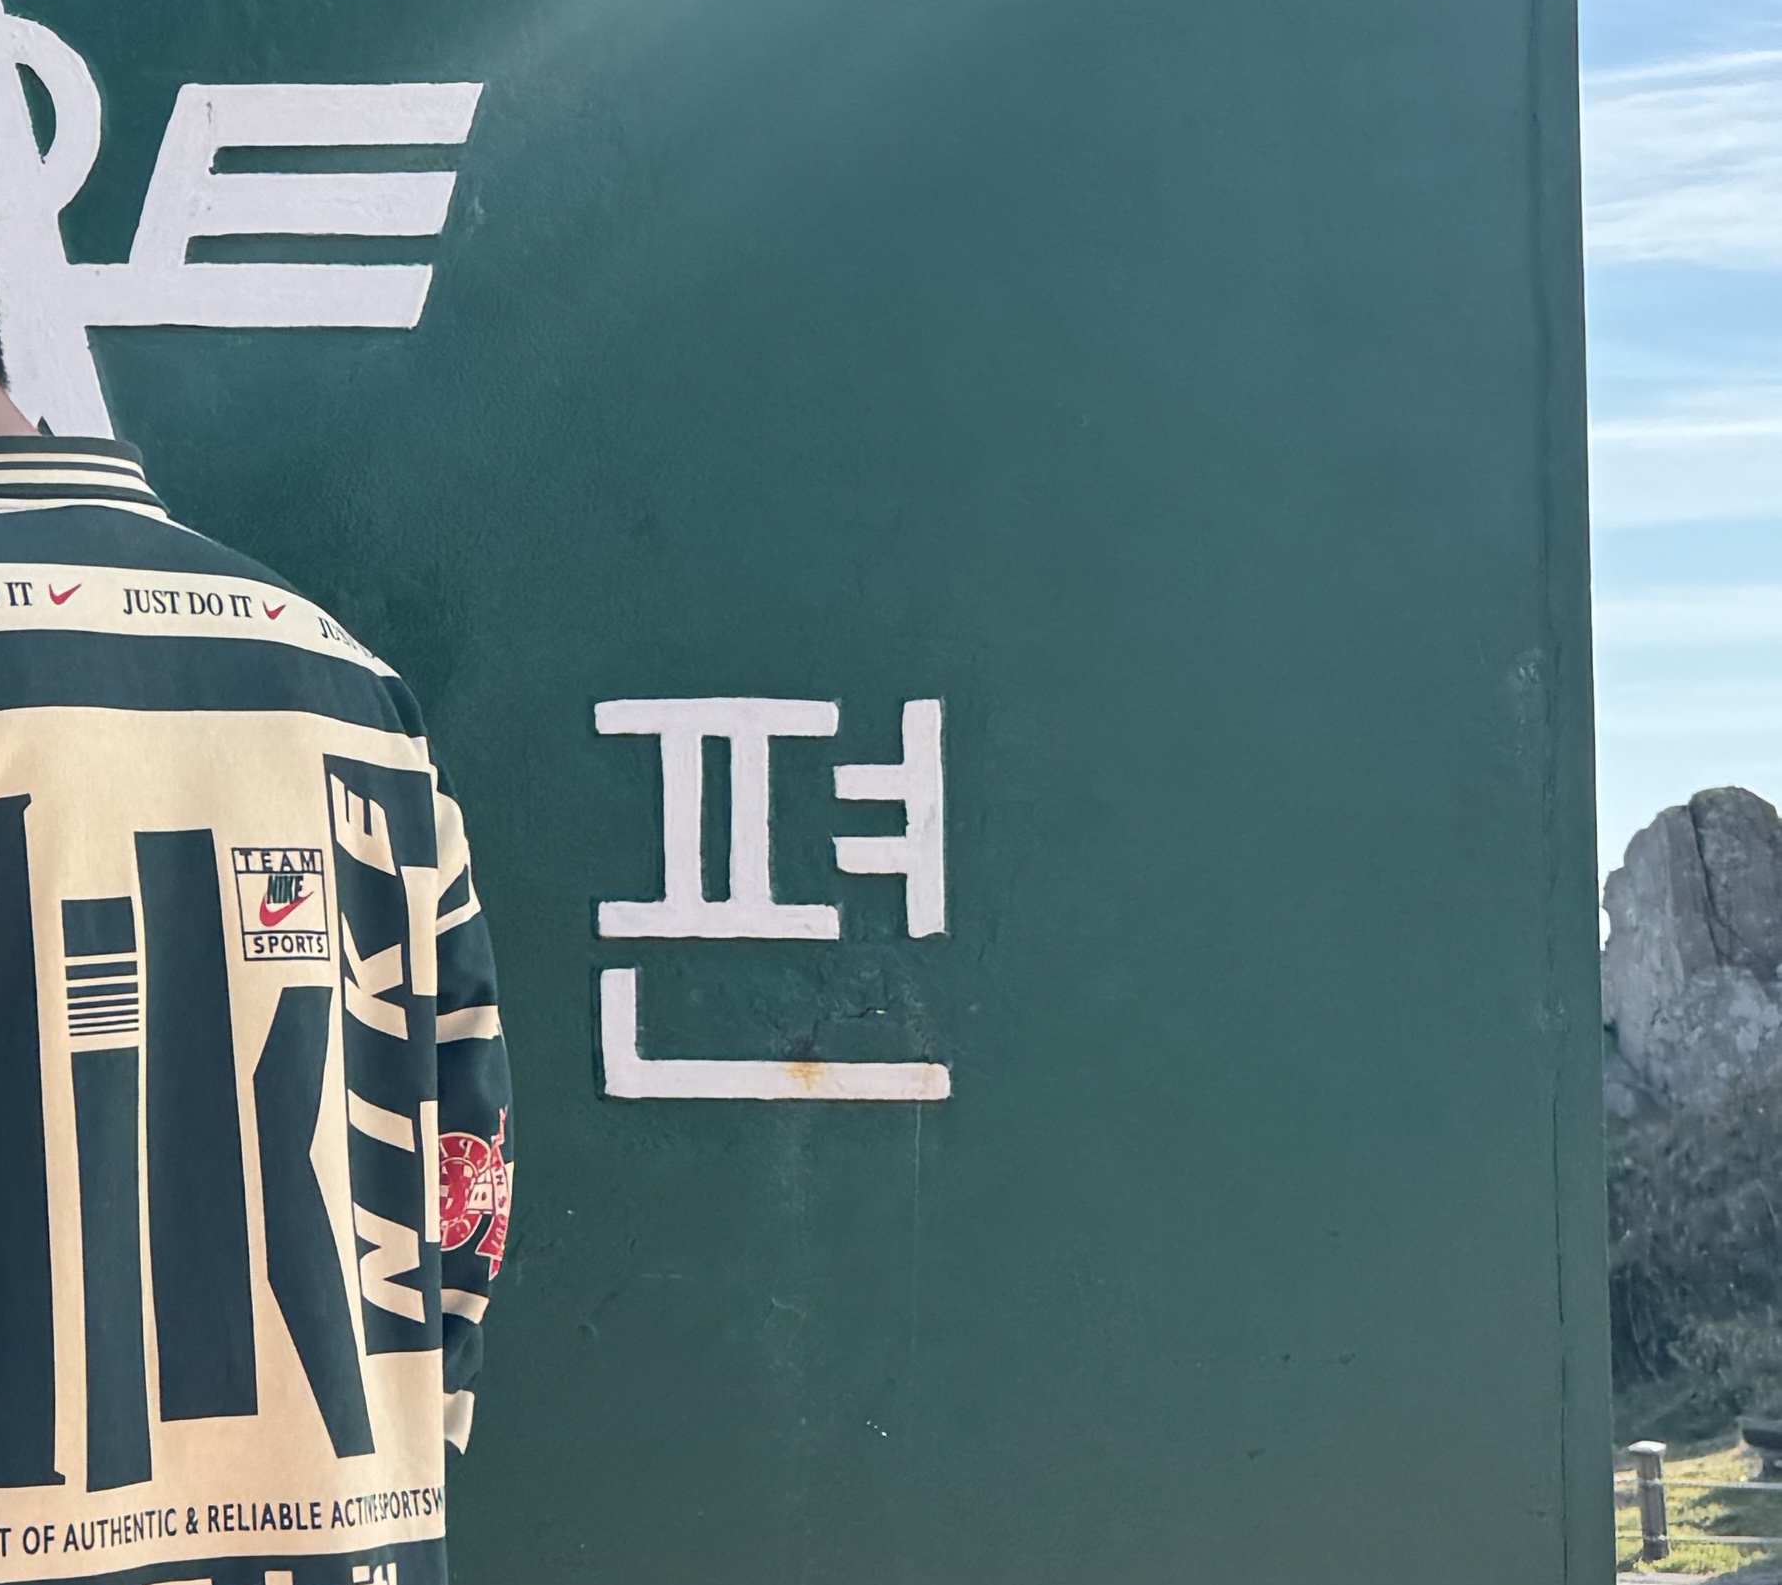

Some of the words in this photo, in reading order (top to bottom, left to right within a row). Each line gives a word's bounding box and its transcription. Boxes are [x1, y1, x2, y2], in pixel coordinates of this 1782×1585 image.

[4, 581, 34, 607] IT
[122, 588, 180, 616] JUST
[186, 591, 224, 617] DO
[228, 594, 254, 619] IT
[238, 849, 318, 872] TEAM
[266, 874, 305, 905] NIKE
[593, 696, 952, 1101] 편
[253, 935, 324, 954] SPORTS
[329, 772, 427, 1324] NIKE
[22, 1525, 56, 1555] OF
[63, 1507, 178, 1554] AUTHENTIC
[185, 1506, 200, 1535] &
[207, 1501, 323, 1534] RELIABLE
